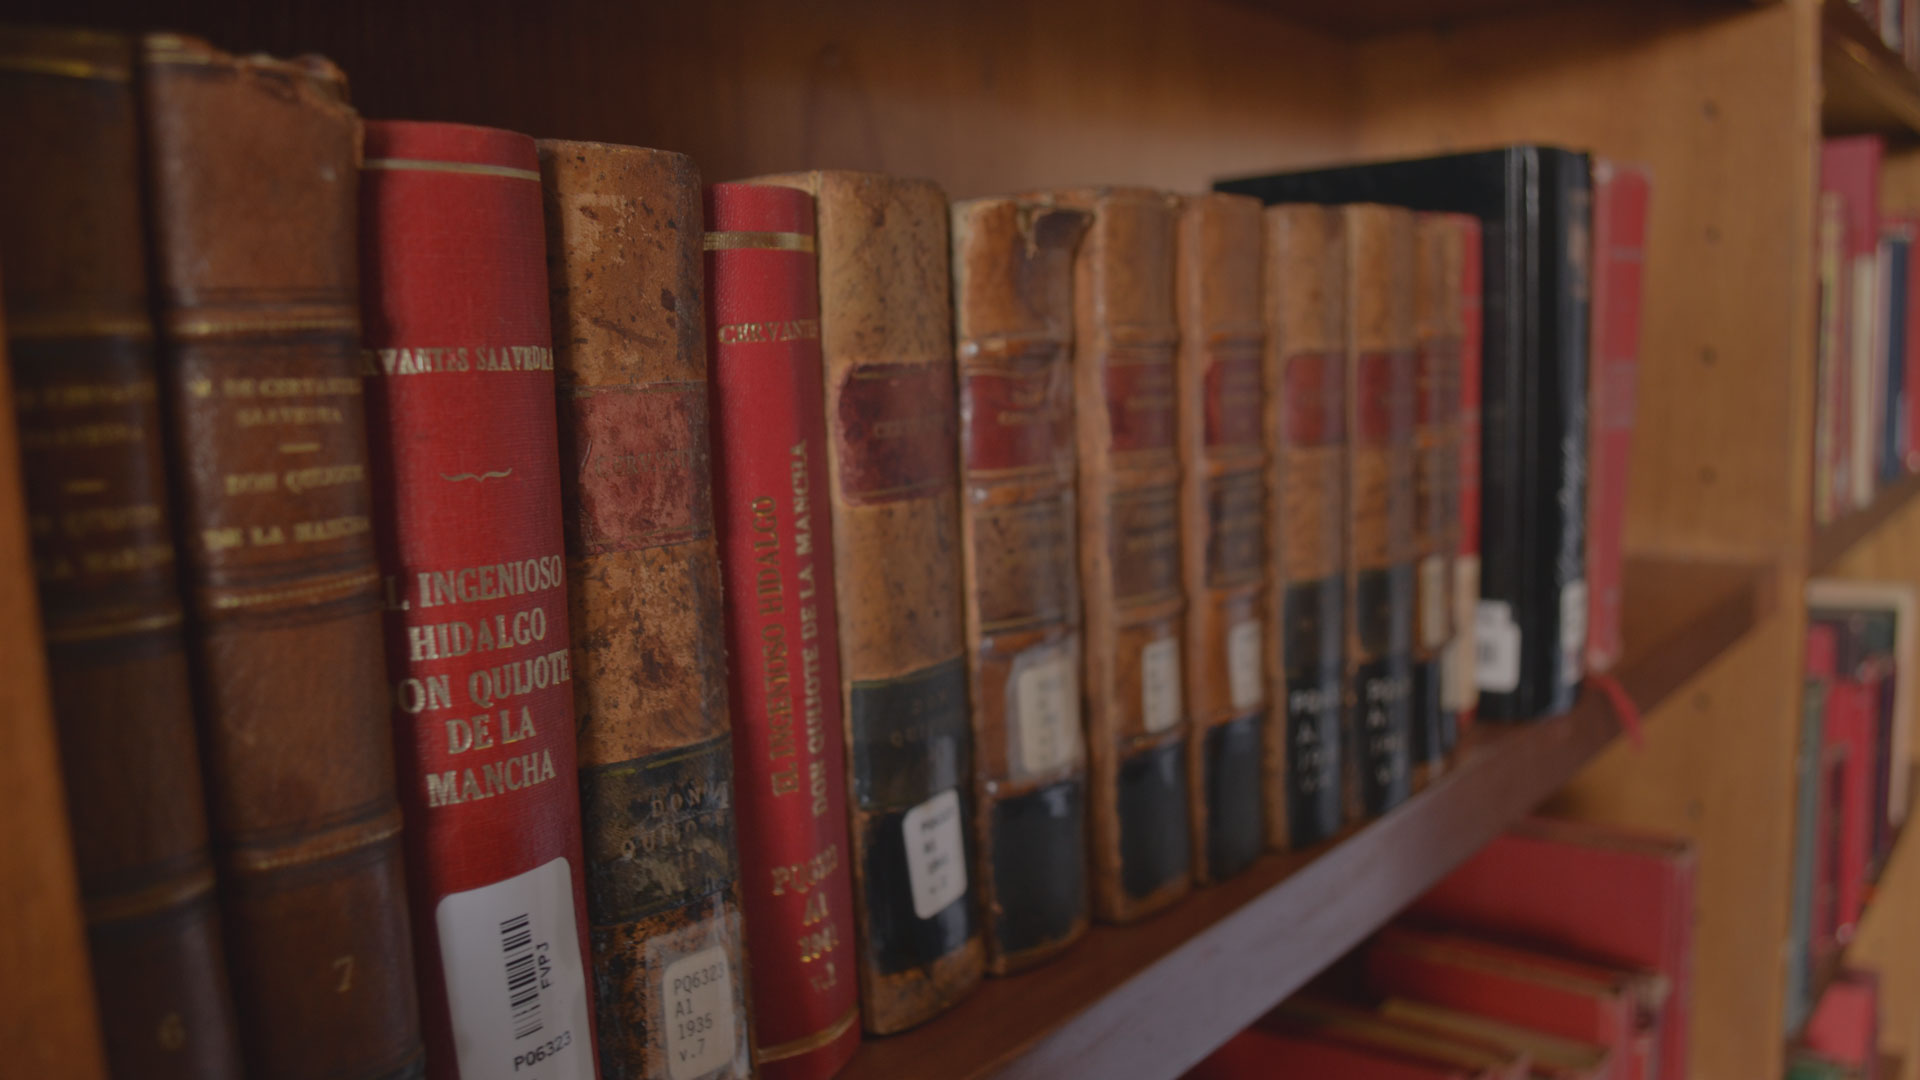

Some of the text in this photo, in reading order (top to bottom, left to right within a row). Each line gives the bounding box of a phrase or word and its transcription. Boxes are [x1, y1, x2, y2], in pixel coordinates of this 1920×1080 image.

[417, 554, 563, 609] INGENIOSO
[408, 607, 547, 662] HIDALGO
[751, 495, 799, 798] EL INGENIOSO HIDALGO
[789, 438, 828, 818] DON QUIJOTE DE LA MANCHA
[468, 648, 570, 710] QUIJOTE
[445, 705, 537, 755] DE LA
[425, 748, 556, 808] MANCHA
[536, 941, 551, 990] FVPJ
